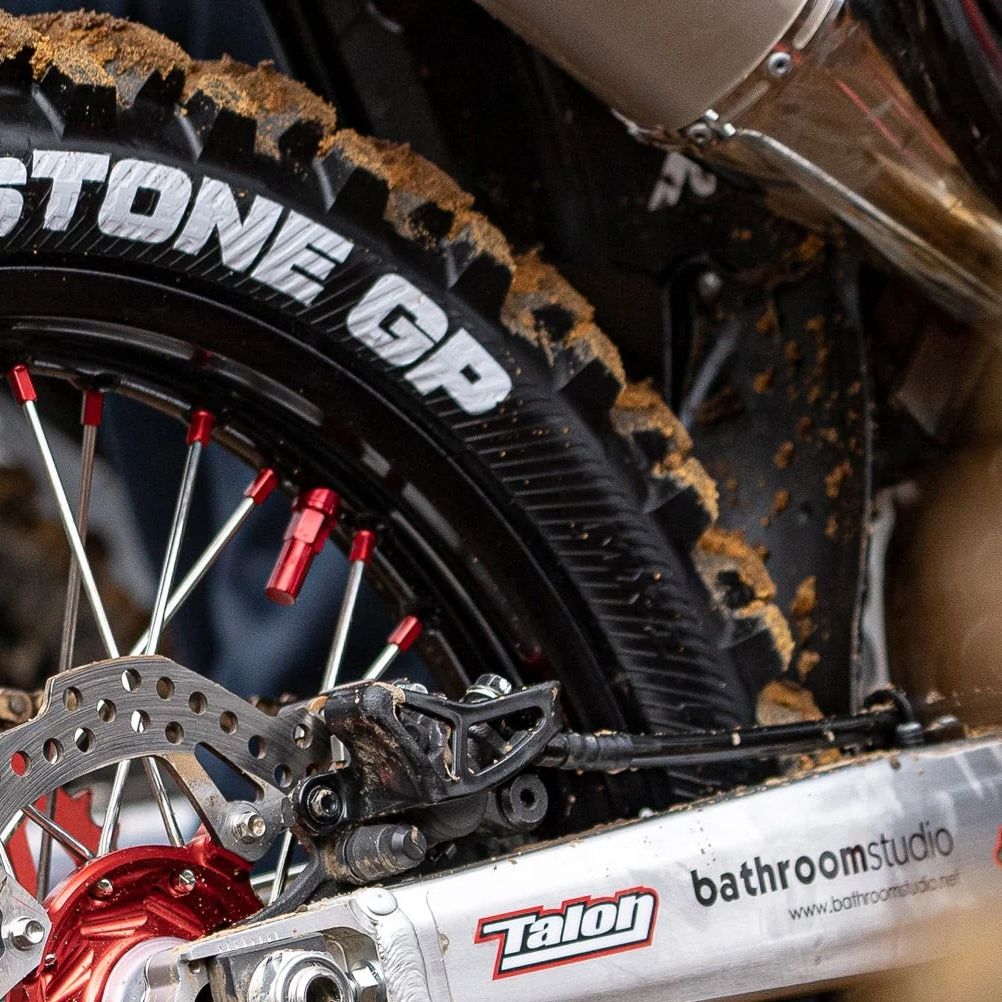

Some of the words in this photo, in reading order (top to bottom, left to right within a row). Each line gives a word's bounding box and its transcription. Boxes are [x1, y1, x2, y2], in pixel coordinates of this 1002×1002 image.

[346, 272, 514, 416] GP
[690, 820, 955, 908] bathroomstudio
[482, 893, 656, 968] Talon
